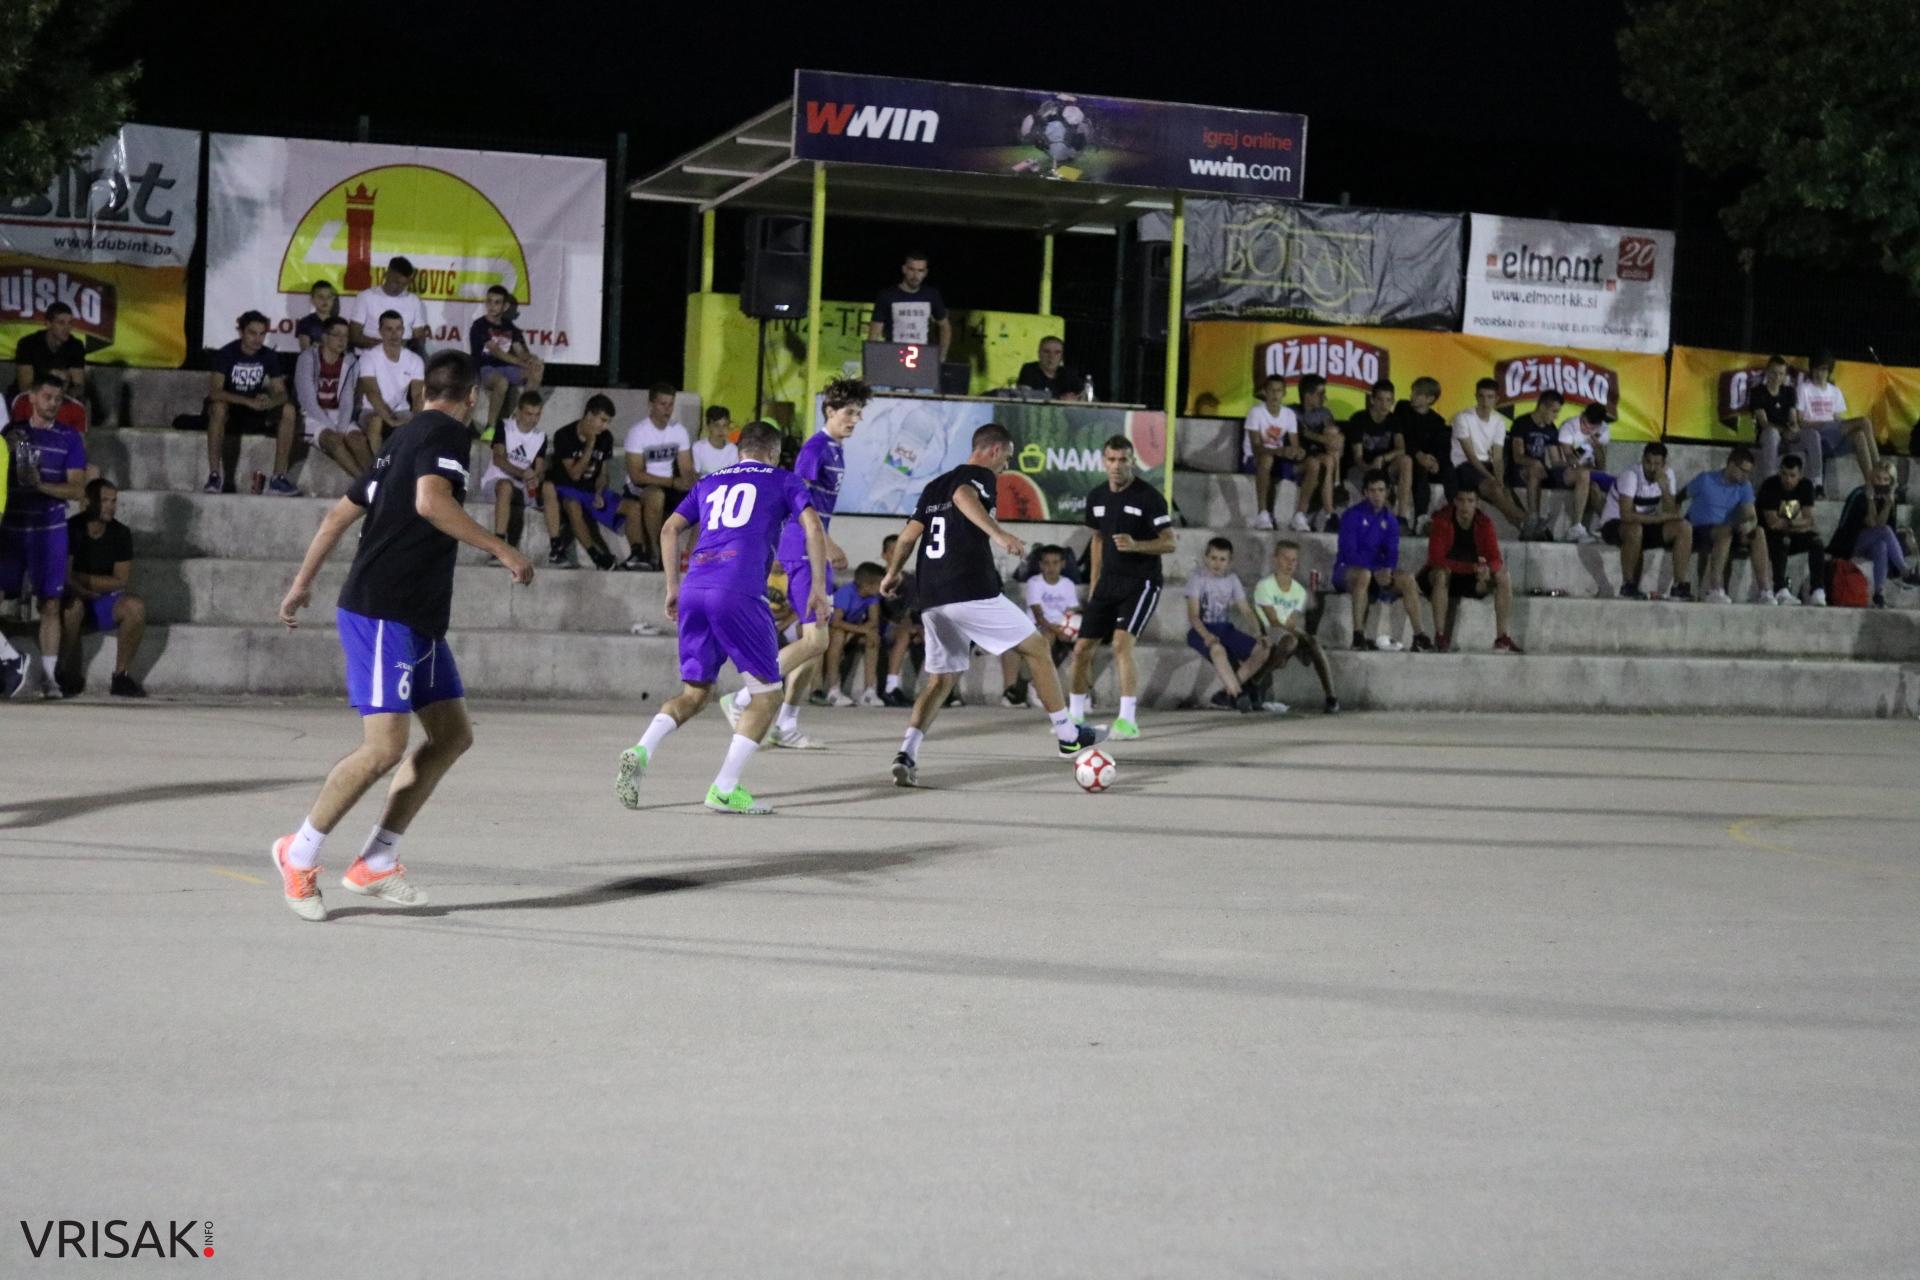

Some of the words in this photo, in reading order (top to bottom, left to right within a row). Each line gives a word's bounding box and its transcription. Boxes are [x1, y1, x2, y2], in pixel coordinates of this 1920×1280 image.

[1203, 127, 1239, 150] igraj
[1242, 132, 1292, 151] online
[1189, 155, 1291, 182] wwin.com
[54, 234, 173, 256] www.dubint.ba
[1618, 241, 1656, 268] 20
[1502, 244, 1603, 283] elmont
[0, 268, 102, 325] ujsko
[1491, 290, 1598, 310] www.elmont-kk.si
[1046, 447, 1106, 471] NAM
[706, 482, 757, 530] 10
[925, 516, 946, 559] 3
[398, 670, 410, 701] 6
